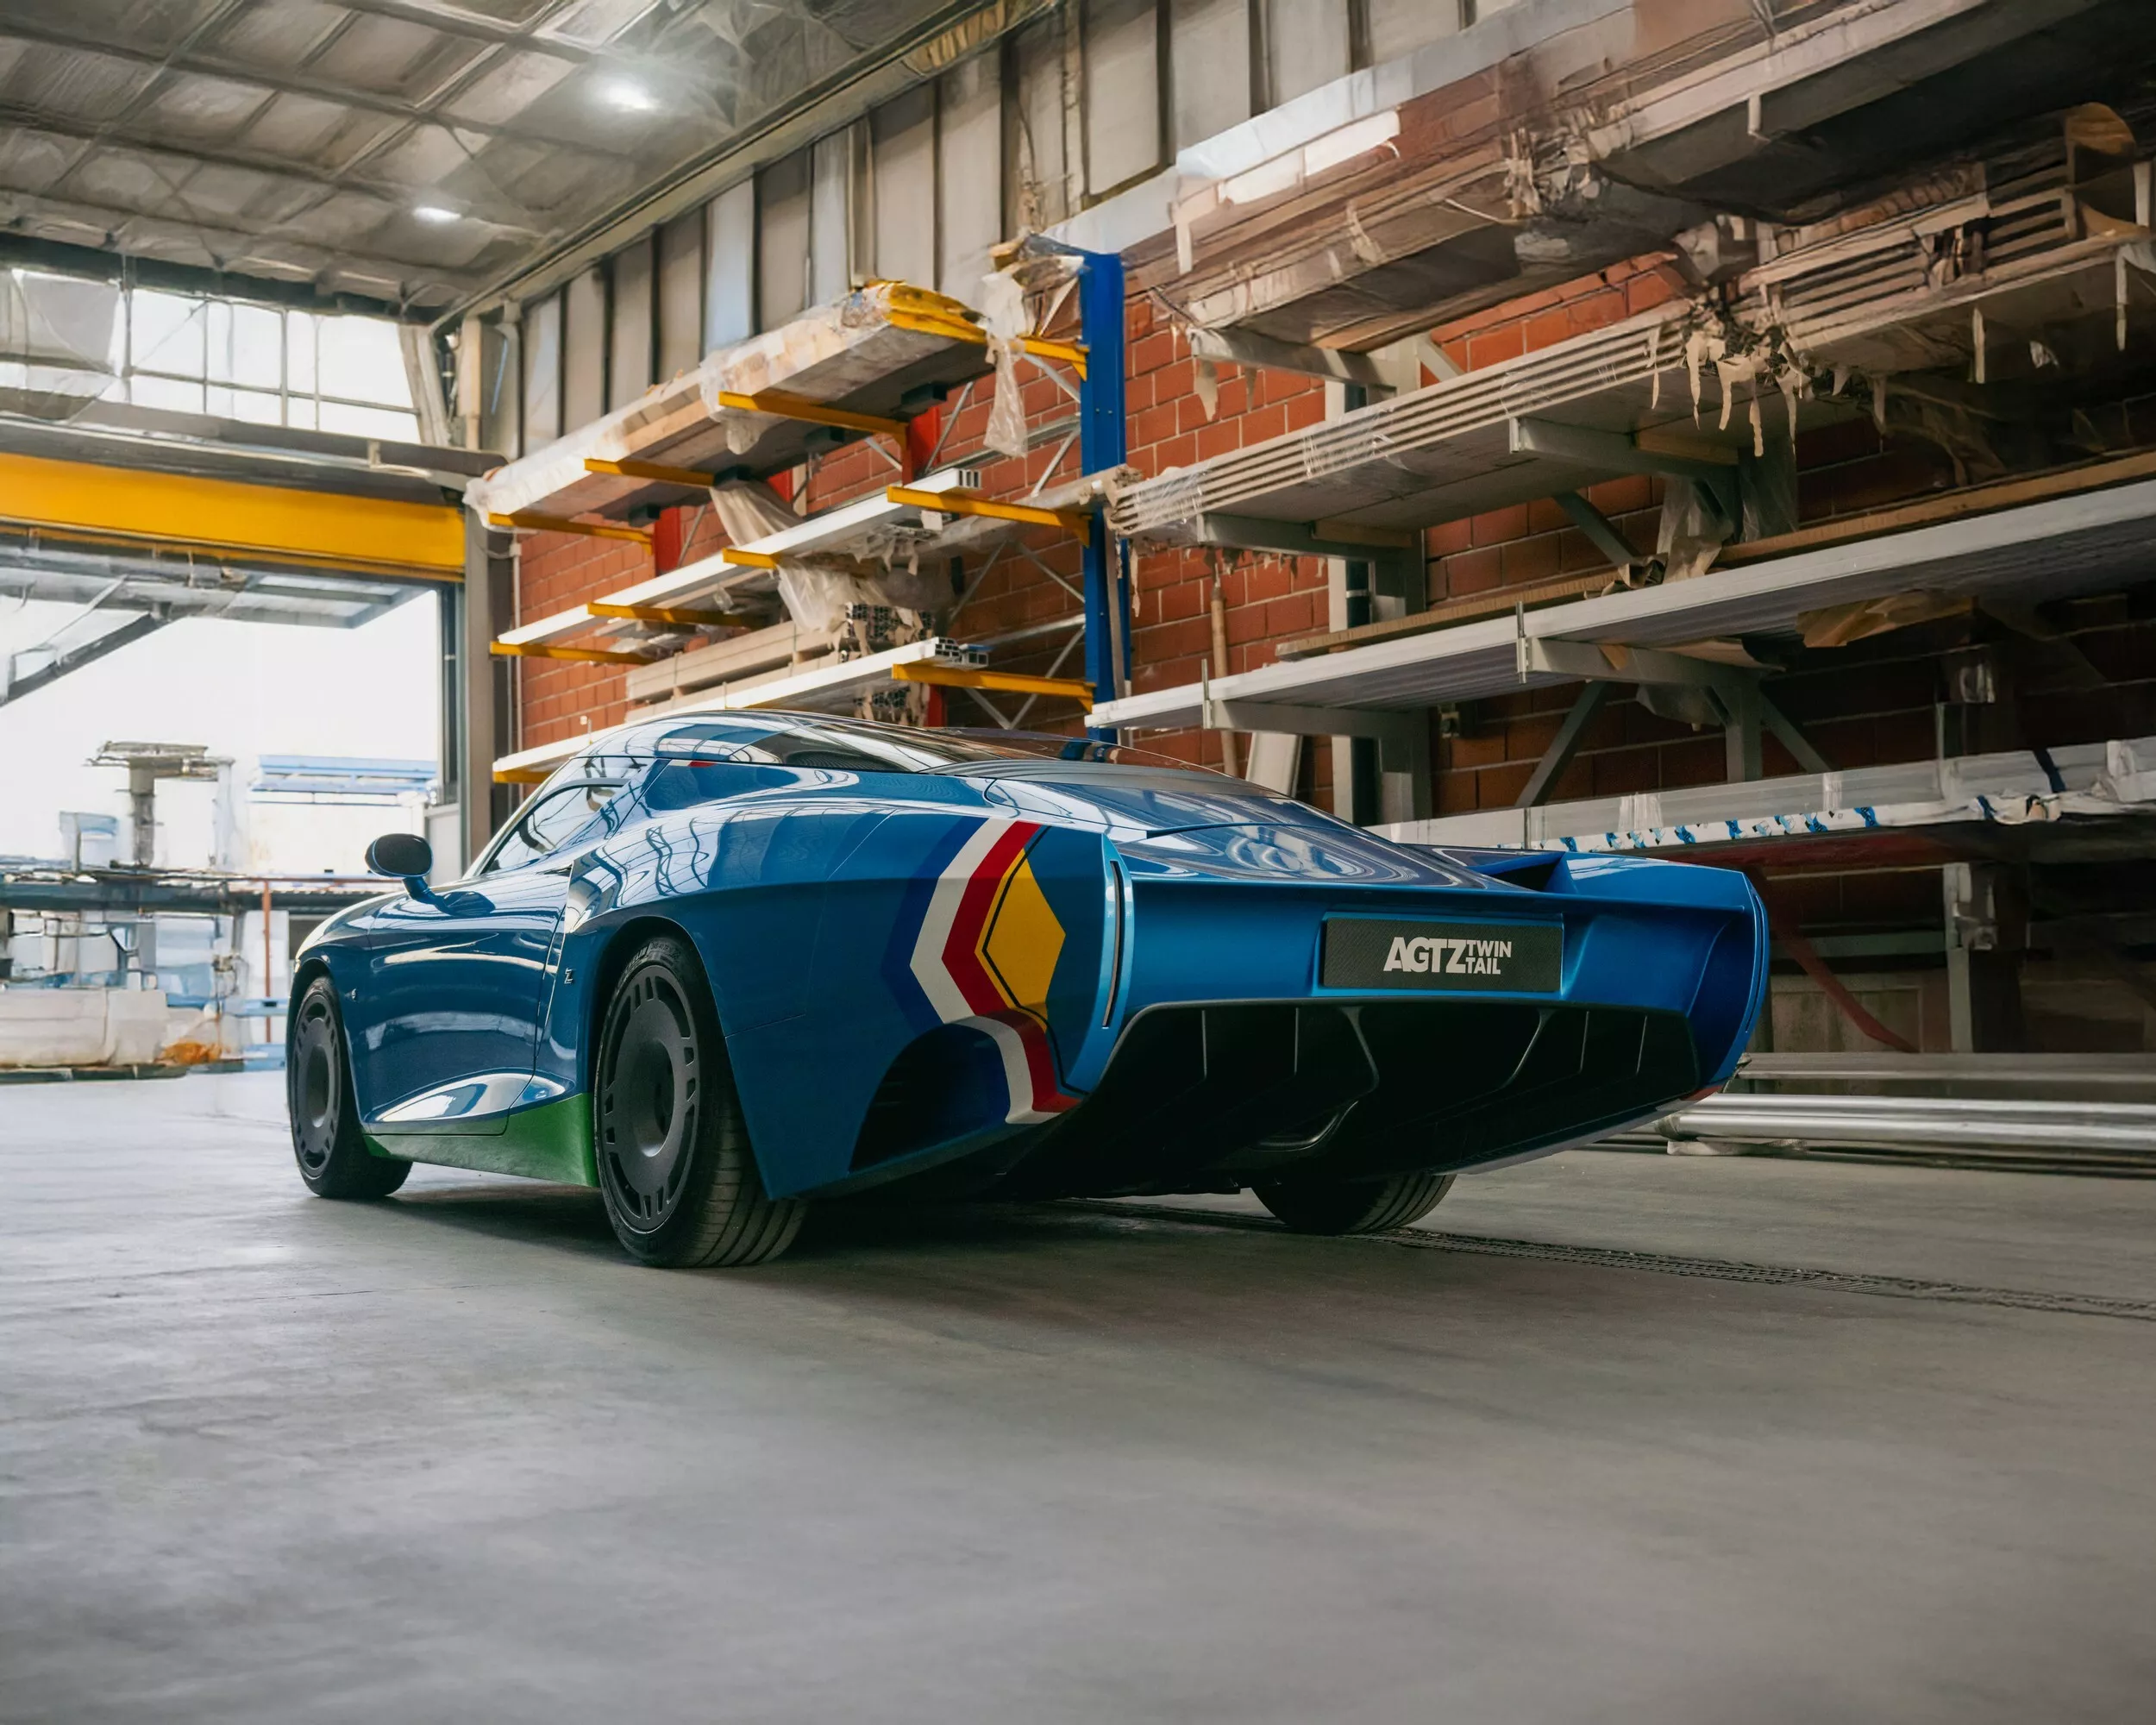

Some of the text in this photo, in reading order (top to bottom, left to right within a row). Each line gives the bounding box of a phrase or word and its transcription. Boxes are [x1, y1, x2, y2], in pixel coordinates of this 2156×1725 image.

[1383, 937, 1467, 974] AGTZ
[1466, 939, 1512, 958] TWIN
[1465, 957, 1501, 975] TAIL
